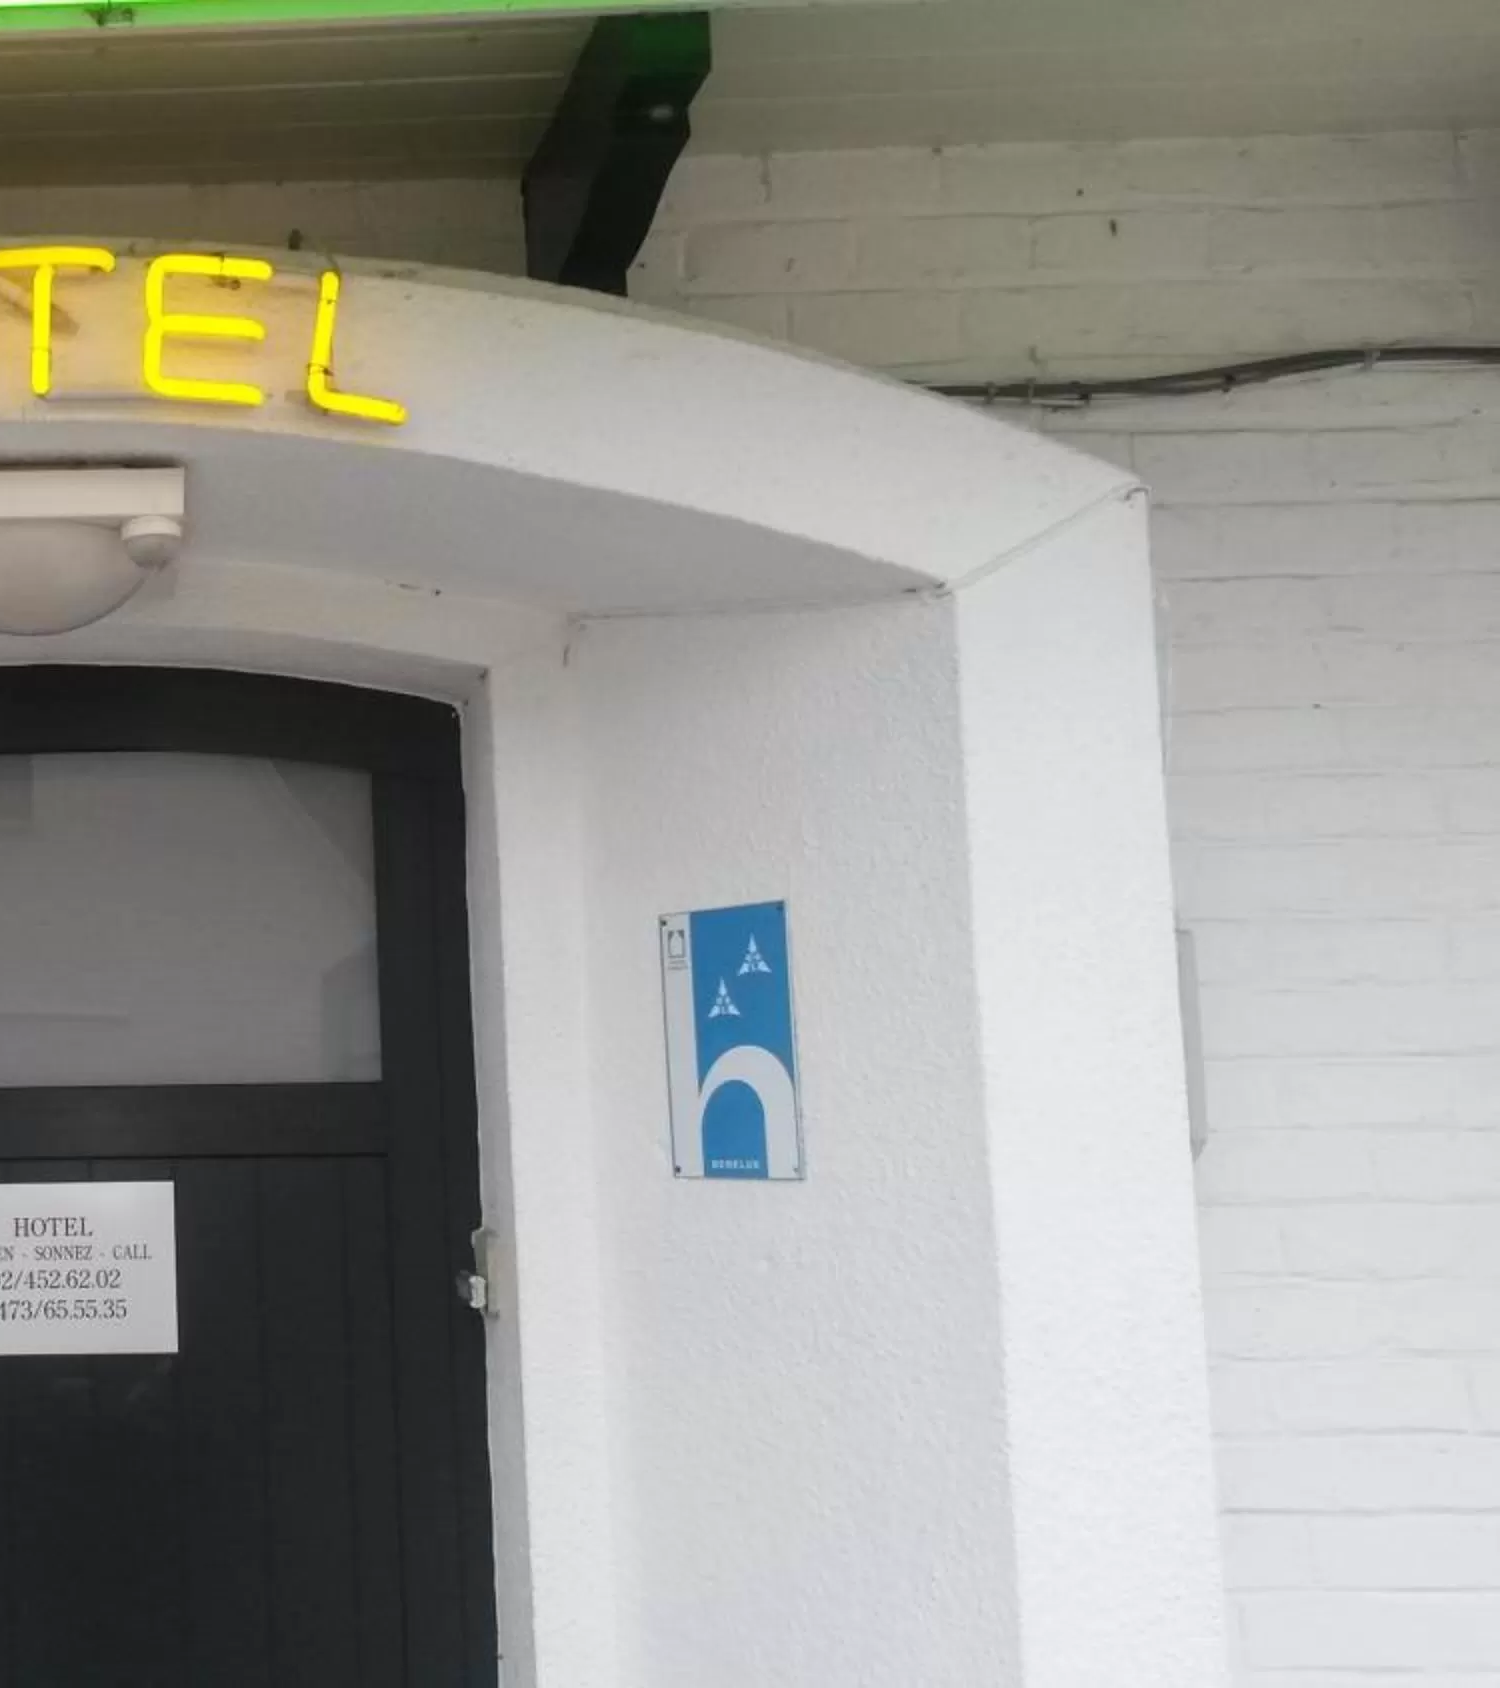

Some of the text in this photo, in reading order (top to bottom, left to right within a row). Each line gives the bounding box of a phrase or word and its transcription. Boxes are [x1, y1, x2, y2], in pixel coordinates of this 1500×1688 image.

[13, 1216, 94, 1238] HOTEL
[34, 1245, 93, 1262] SONNEZ
[112, 1243, 153, 1261] CALL
